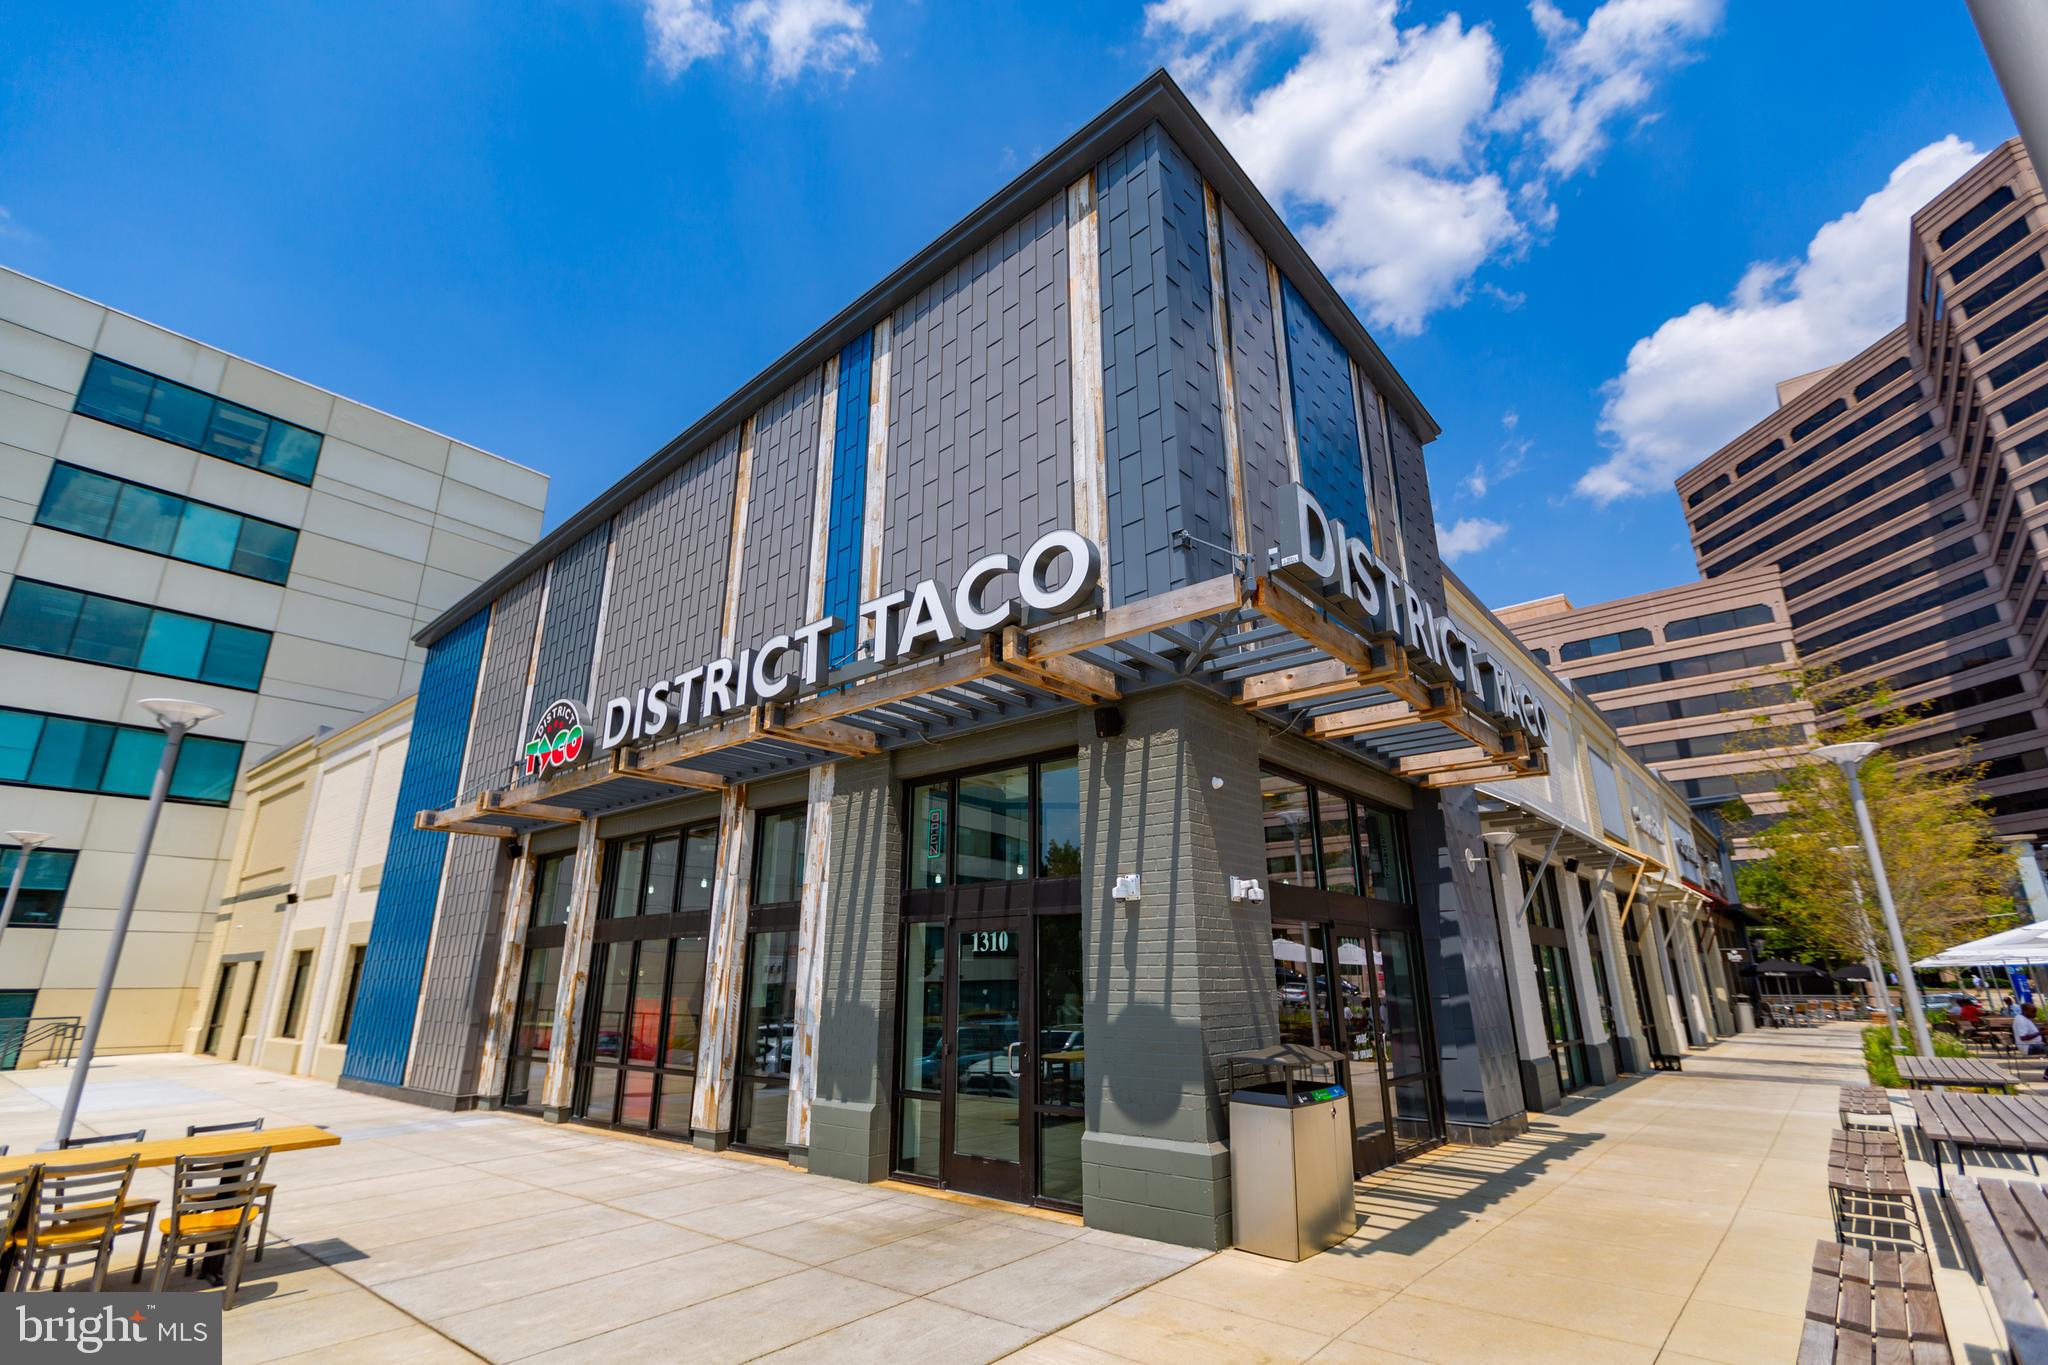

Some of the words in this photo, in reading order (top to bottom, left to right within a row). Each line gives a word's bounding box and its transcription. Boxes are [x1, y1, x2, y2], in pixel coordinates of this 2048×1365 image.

[1296, 482, 1485, 702] DISTRICT
[1487, 654, 1552, 747] TACO
[602, 616, 841, 749] DISTRICT
[861, 529, 1097, 663] TACO
[537, 705, 576, 736] DISTRICT
[525, 725, 584, 778] TACO
[929, 812, 940, 856] OPEN
[971, 931, 1008, 952] 1310
